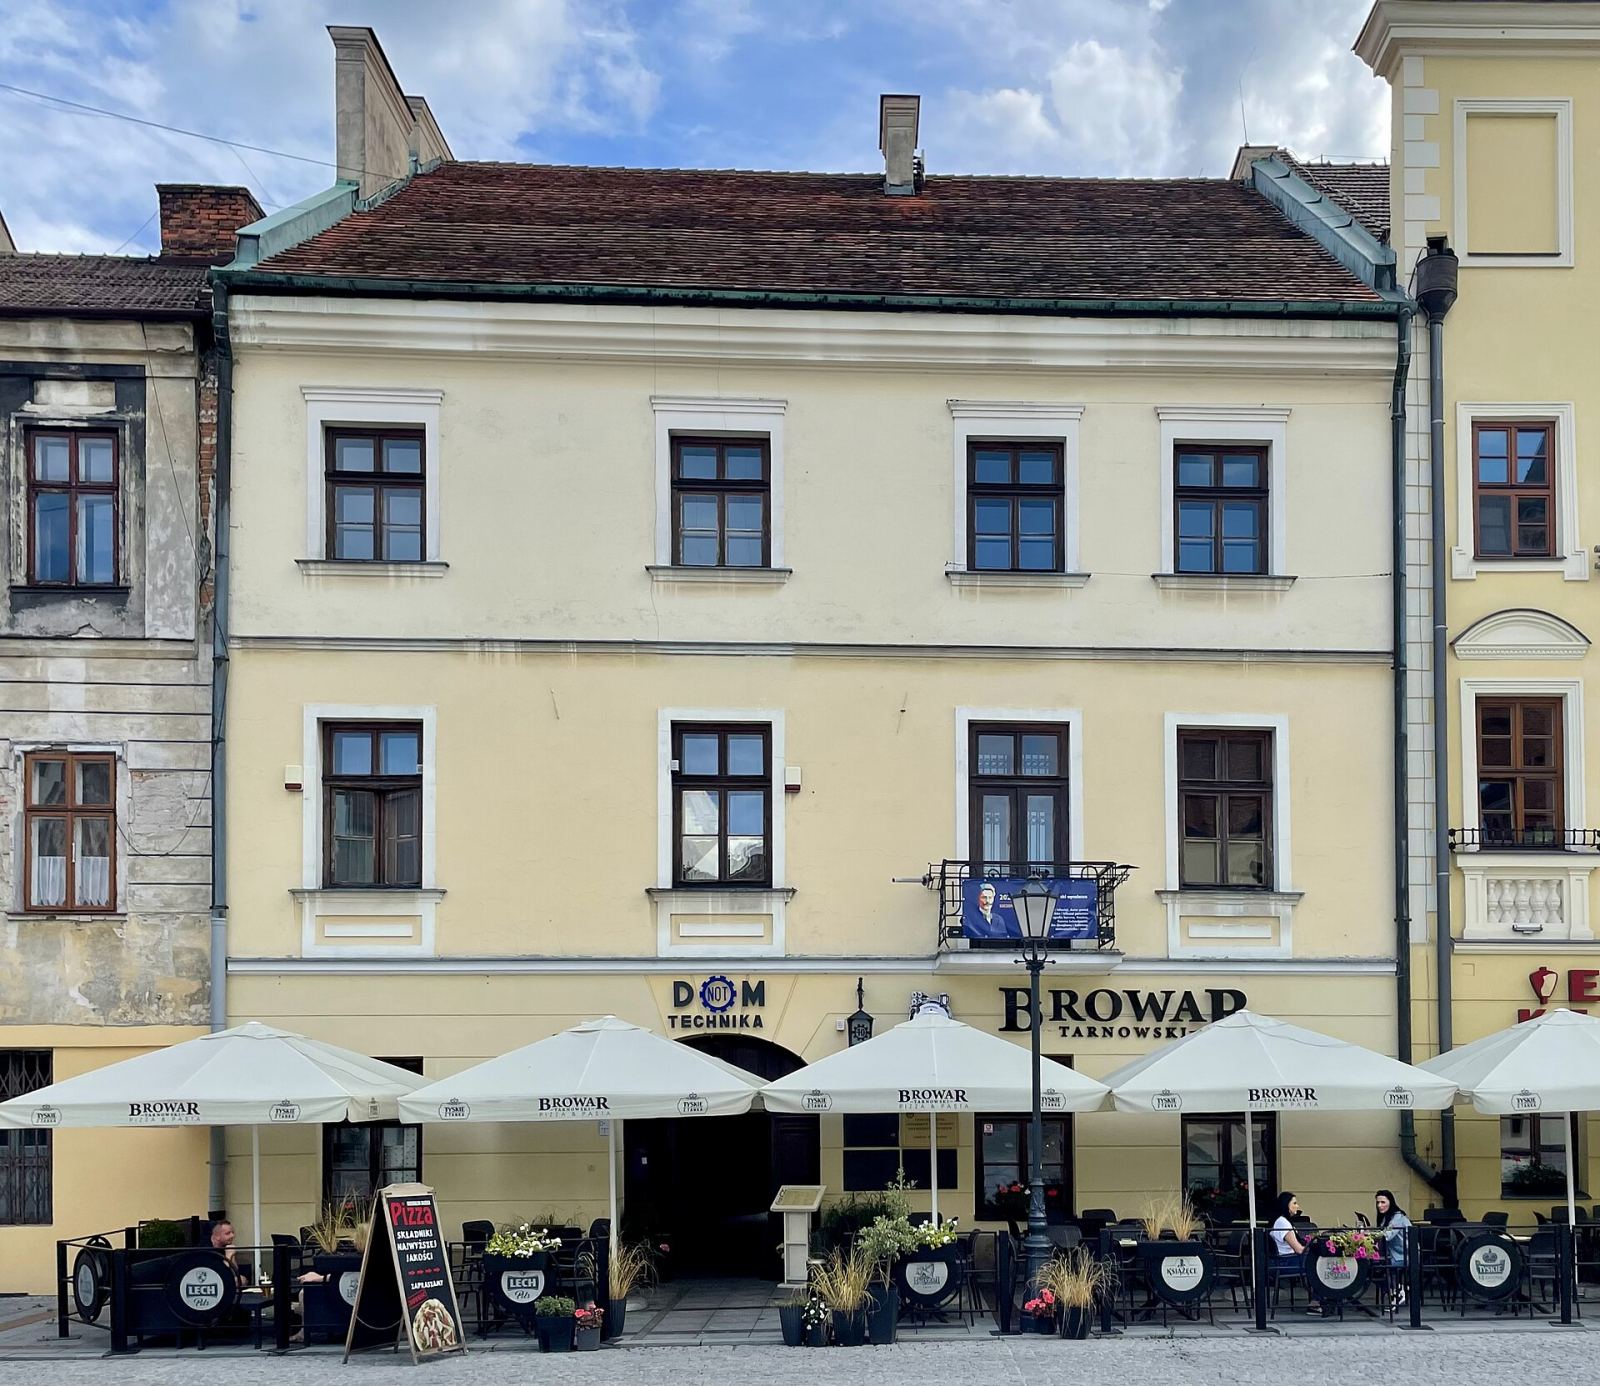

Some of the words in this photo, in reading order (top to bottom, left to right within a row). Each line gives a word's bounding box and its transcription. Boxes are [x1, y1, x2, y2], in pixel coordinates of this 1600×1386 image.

[708, 986, 728, 1002] NOT
[668, 1015, 764, 1028] TECHNIKA
[1058, 1026, 1186, 1038] TARNOWSKI
[898, 1090, 968, 1102] BROWAR
[1248, 1088, 1318, 1101] BROWAR
[129, 1102, 200, 1116] BROWAR
[538, 1096, 610, 1111] BROWAR
[390, 1202, 433, 1226] Pizza
[397, 1229, 432, 1239] SKŁADNIKI
[397, 1240, 437, 1250] NAJWYŻSZEJ
[406, 1250, 433, 1262] JAKOŚCI
[411, 1280, 444, 1290] ZAPRASZAMY
[510, 1278, 536, 1288] LECH
[188, 1286, 216, 1295] LECH
